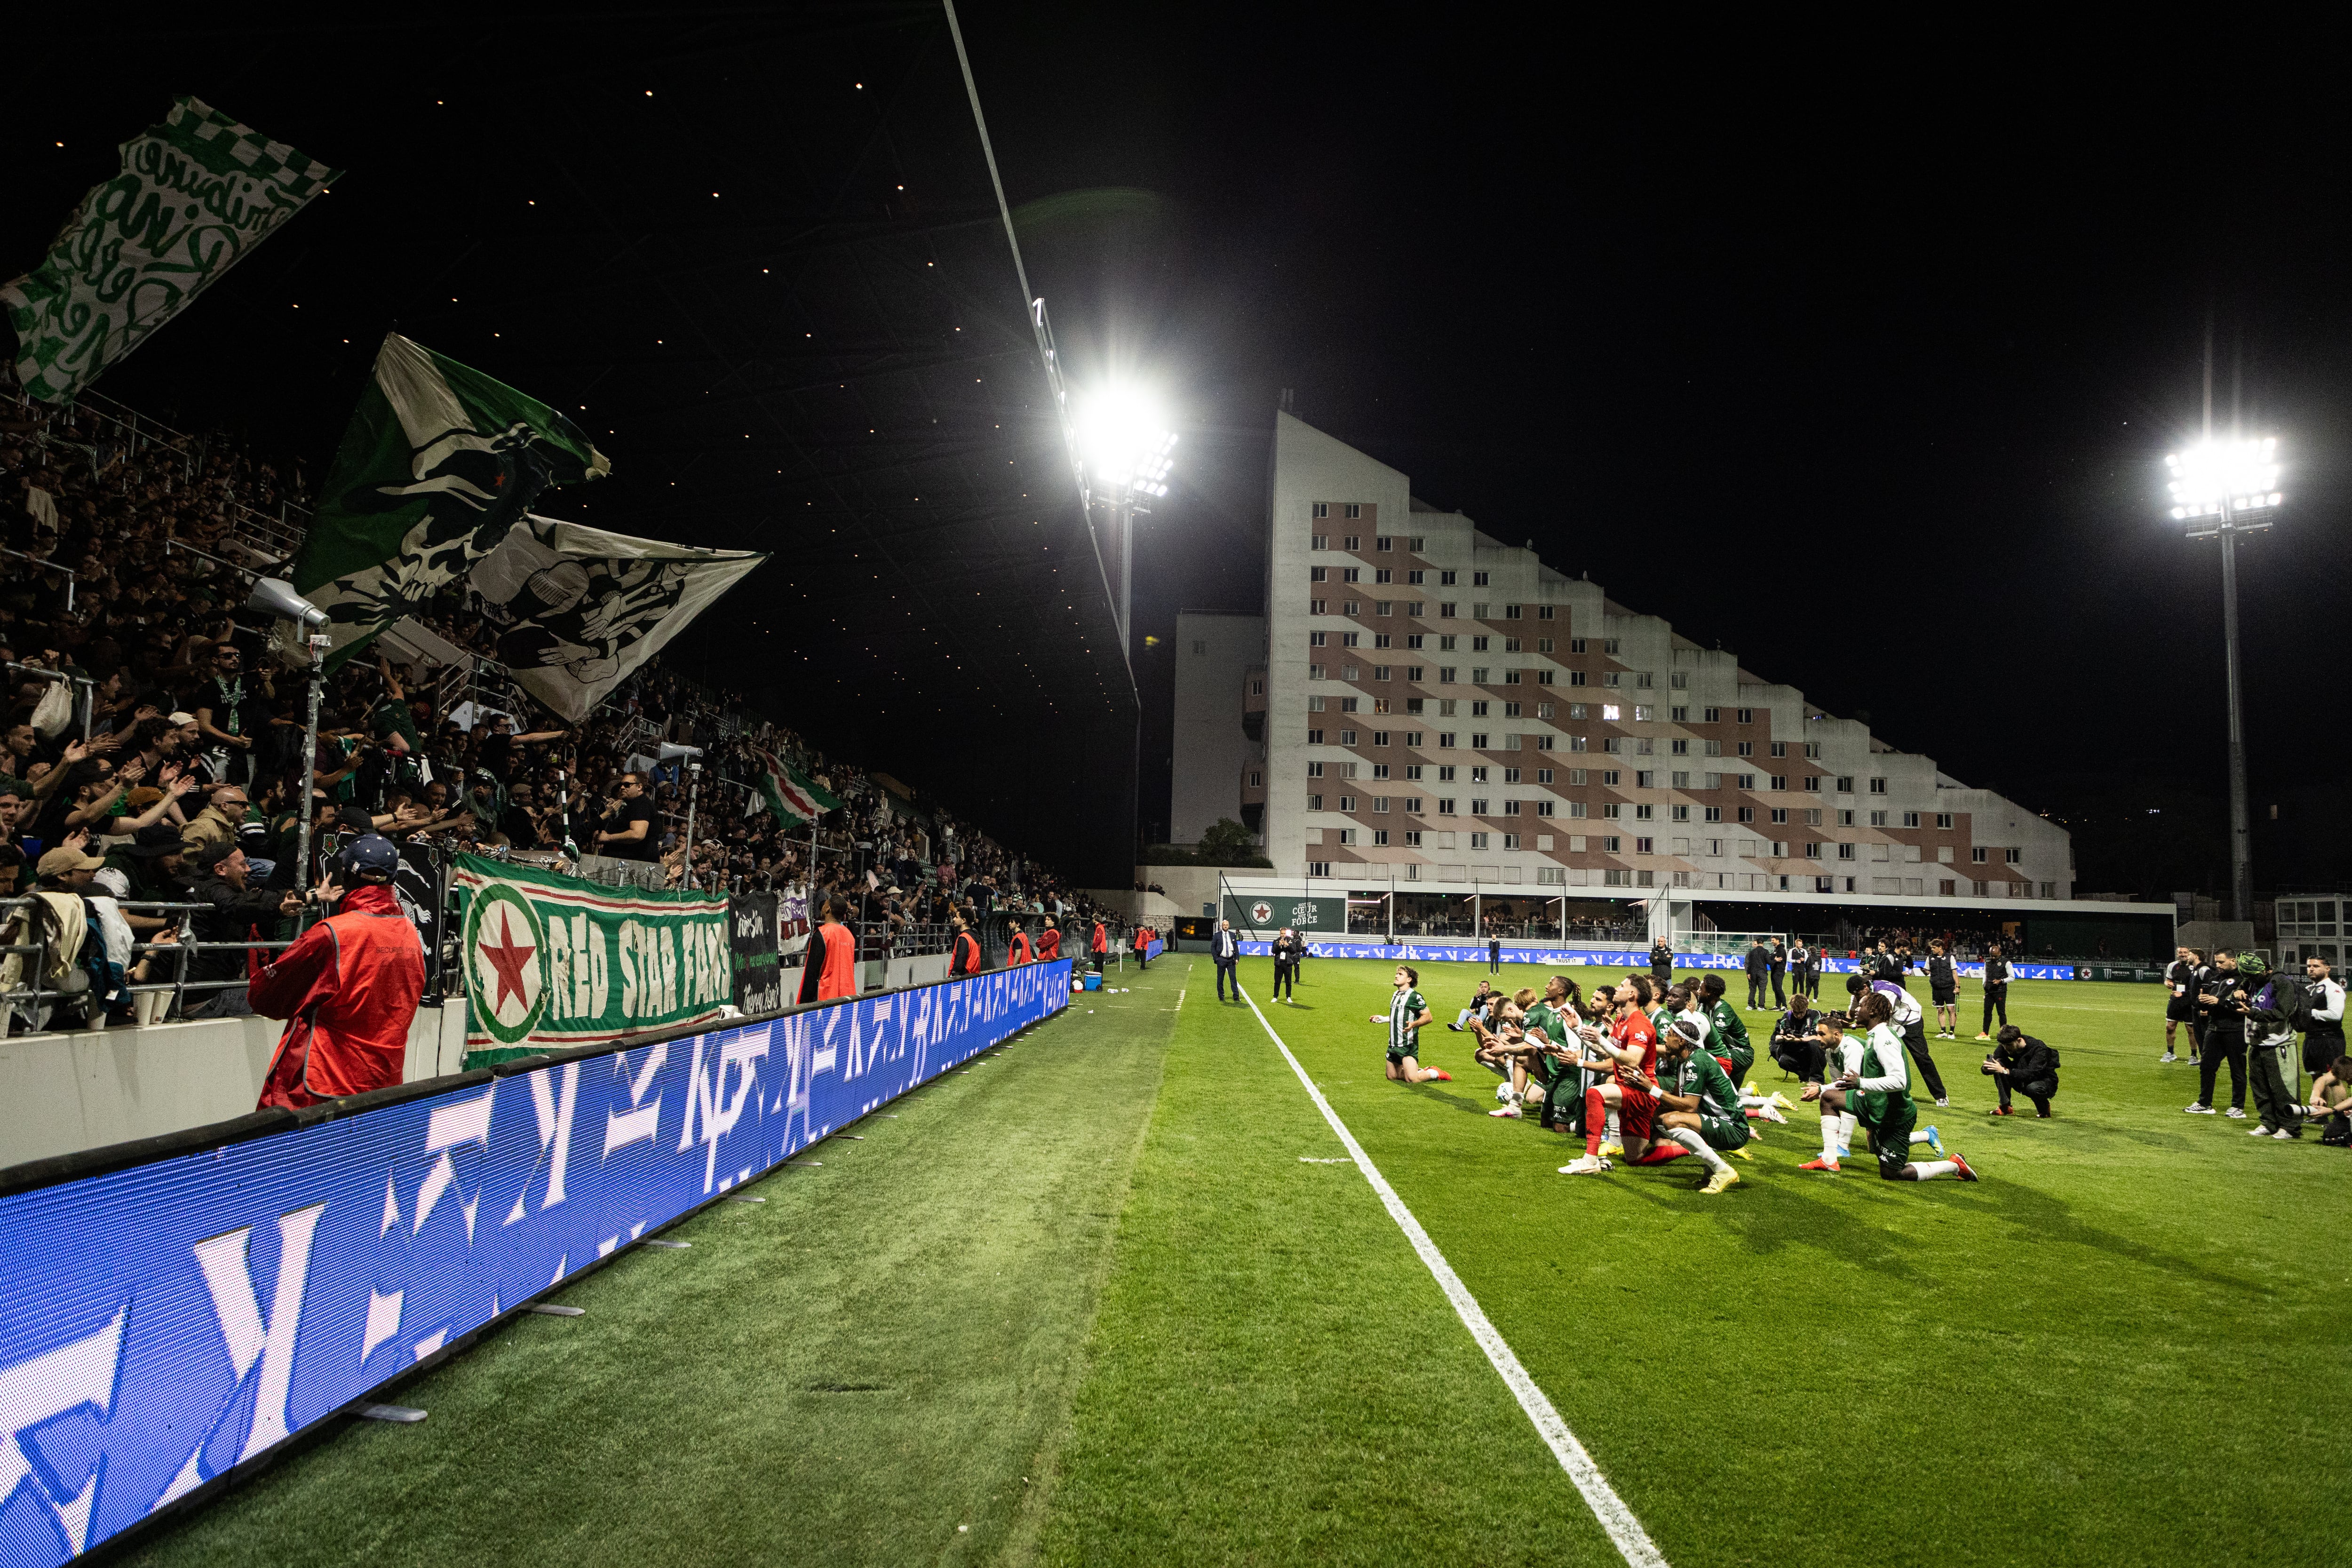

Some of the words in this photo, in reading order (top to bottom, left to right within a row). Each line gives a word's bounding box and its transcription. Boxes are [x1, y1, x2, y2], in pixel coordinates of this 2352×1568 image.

[1291, 915, 1318, 926] FORCE
[549, 912, 608, 1020] RED
[619, 918, 677, 1018] STAR
[683, 918, 731, 1007] FANS
